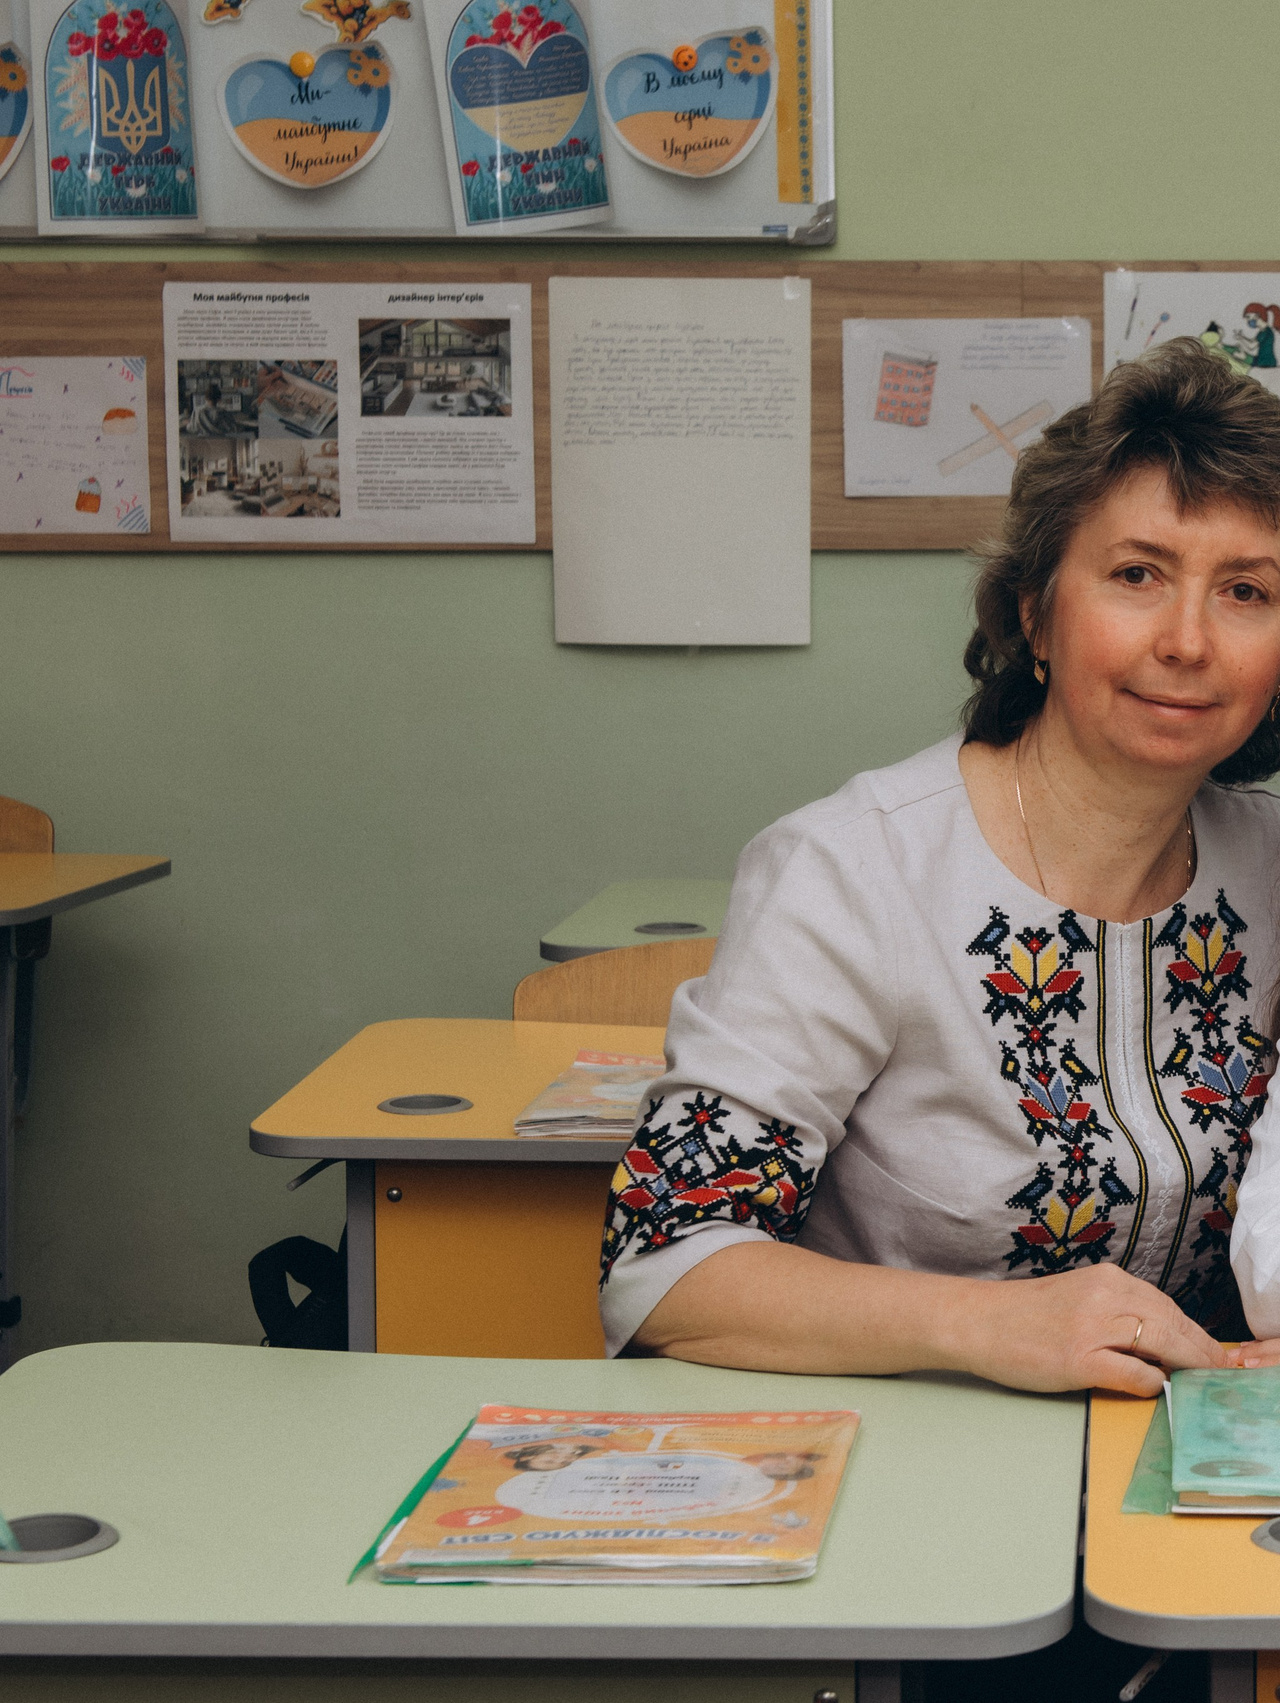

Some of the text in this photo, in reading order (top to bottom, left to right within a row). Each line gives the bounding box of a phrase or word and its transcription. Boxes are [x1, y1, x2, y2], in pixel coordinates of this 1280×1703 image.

[643, 72, 661, 94] В
[486, 137, 592, 173] ДЕРЖАВНИЙ
[661, 135, 732, 160] Україна
[79, 149, 182, 170] ДЕРЖАВНИЙ
[284, 147, 359, 174] України!
[115, 173, 155, 190] ГЕРБ
[522, 168, 566, 187] ГІМН
[99, 194, 172, 212] УКРАЇНИ
[511, 187, 584, 212] УКРАЇНИ
[193, 290, 310, 305] Моя майбутня професія
[388, 290, 434, 304] дизайнер
[466, 1515, 492, 1526] 4
[443, 1532, 515, 1545] СВІТ
[523, 1530, 743, 1542] ДОСЛІДЖУЮ
